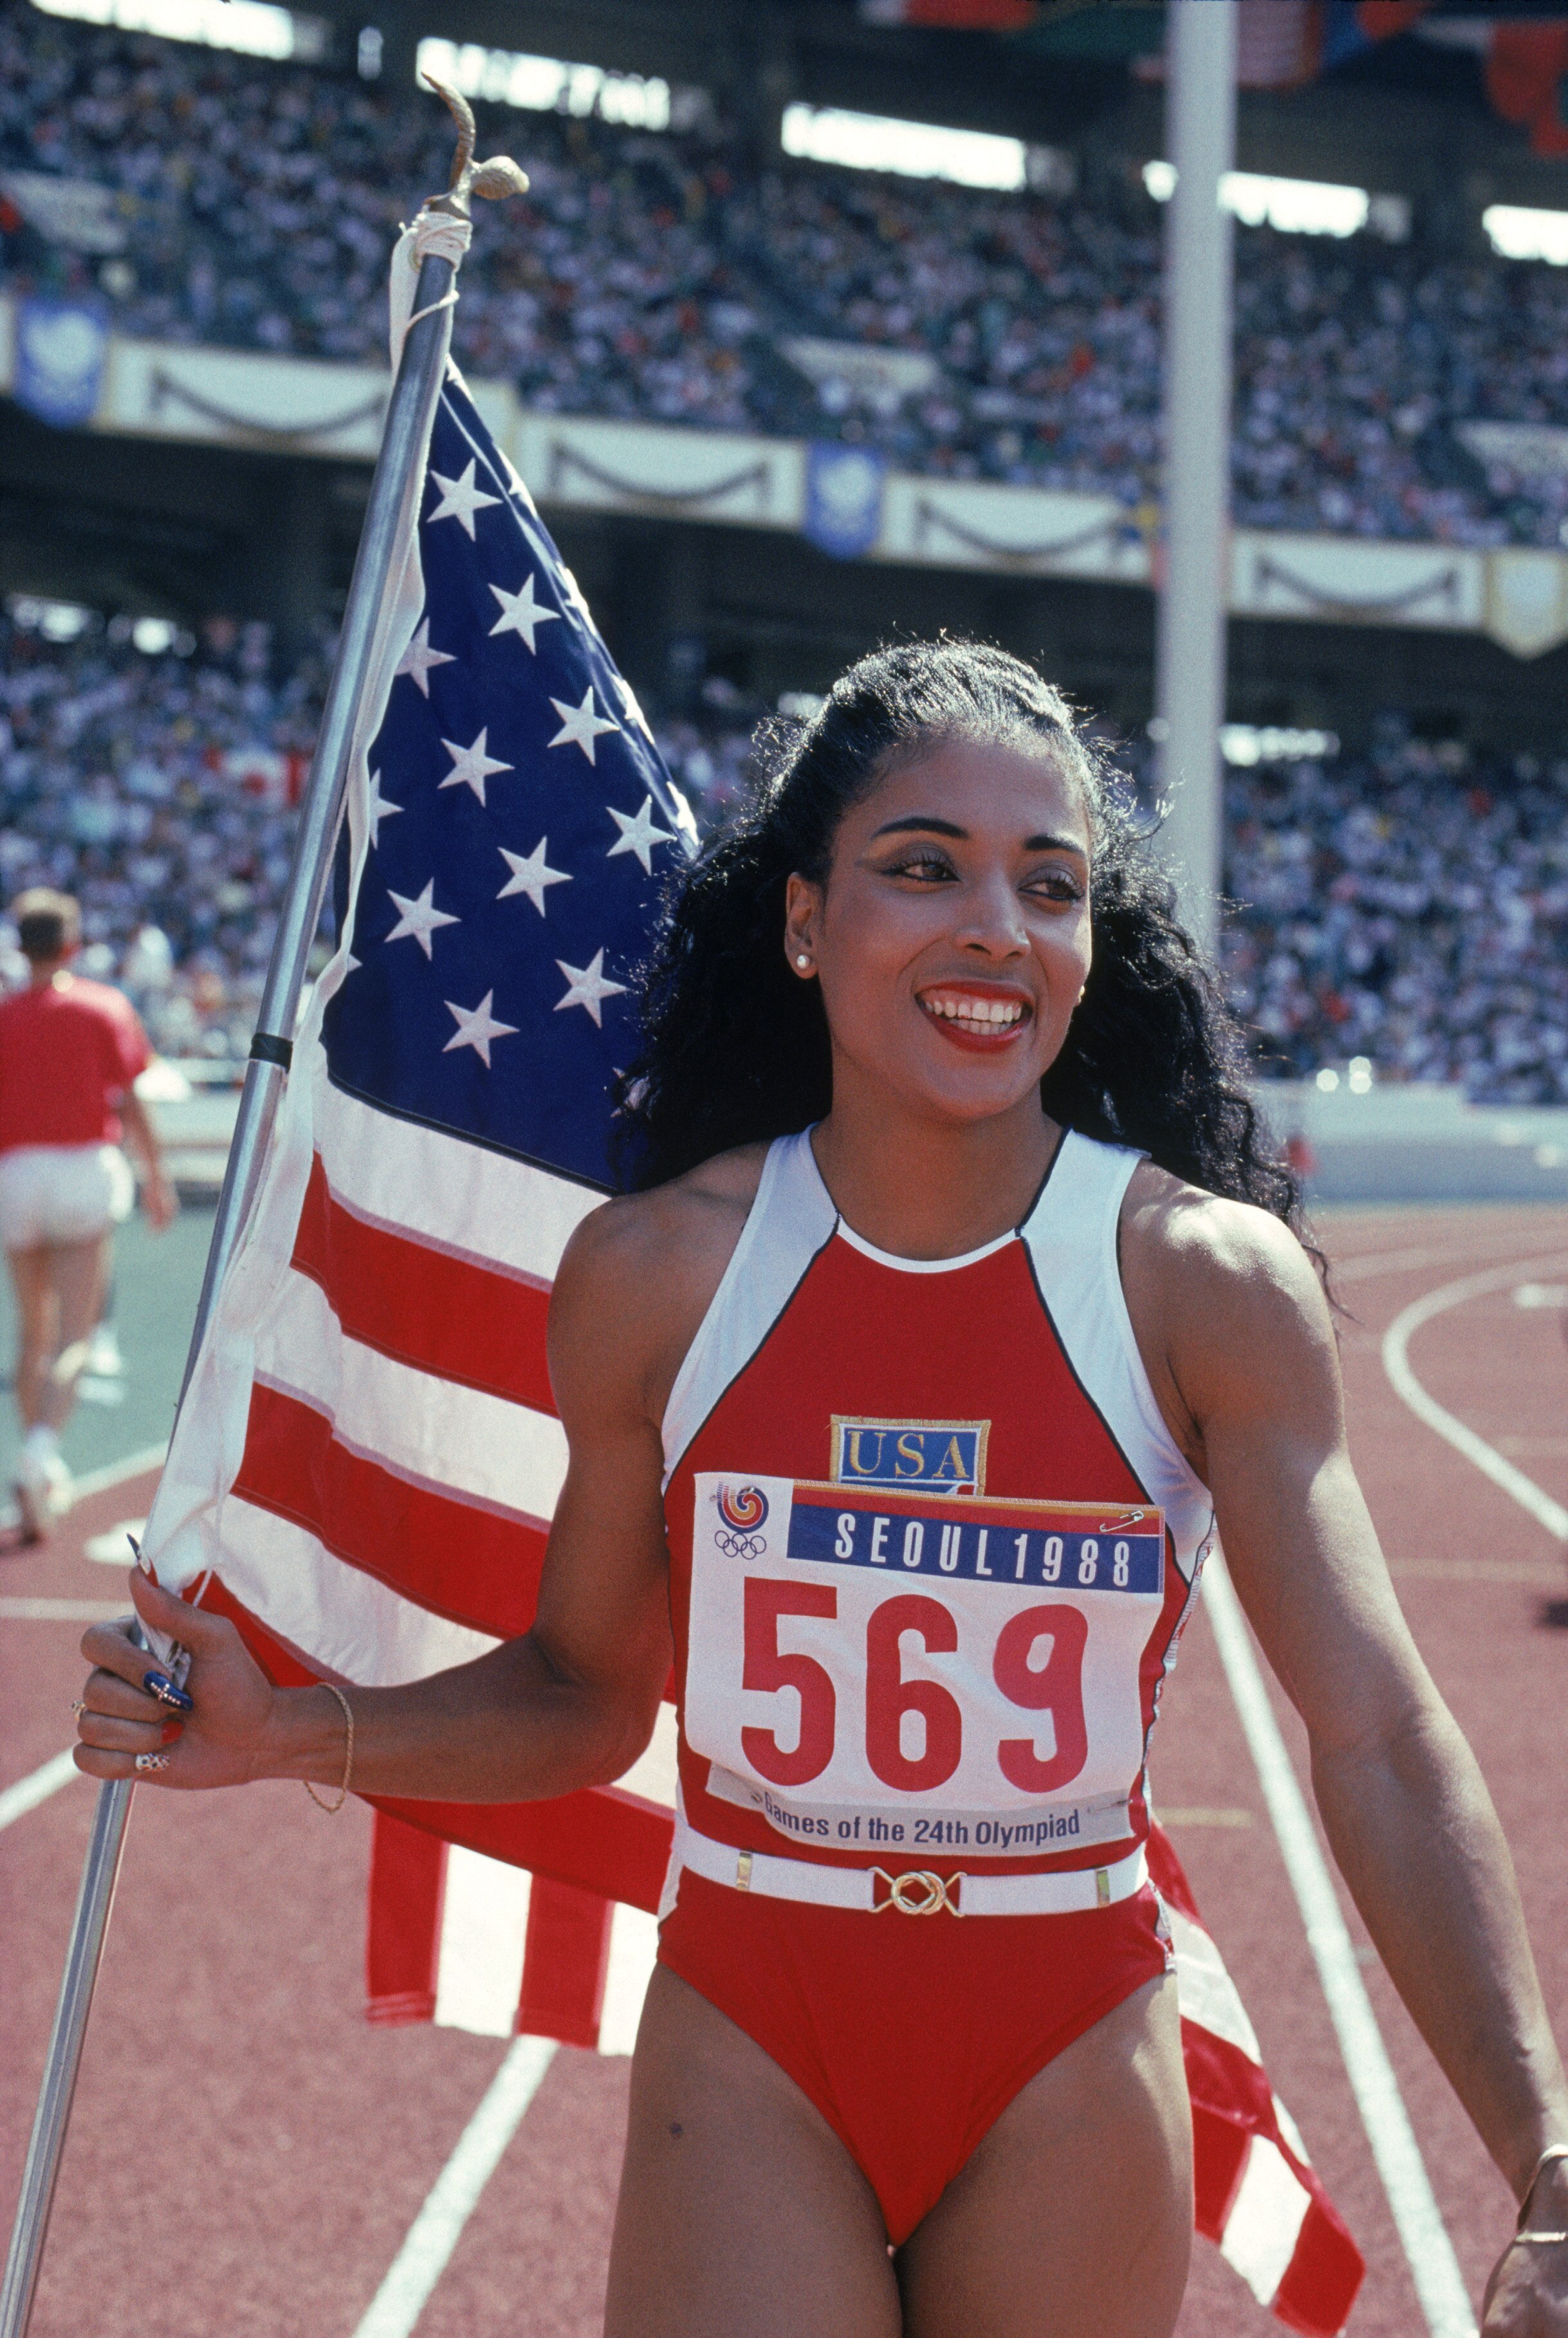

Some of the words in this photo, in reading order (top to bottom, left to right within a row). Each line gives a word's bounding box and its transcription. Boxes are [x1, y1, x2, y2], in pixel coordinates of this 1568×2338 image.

[847, 1431, 970, 1478] USA
[835, 1513, 992, 1575] SEOUL
[1015, 1534, 1130, 1587] 1988
[741, 1576, 1088, 1794] 569
[764, 1791, 829, 1835] Games
[838, 1816, 861, 1839] of
[868, 1817, 905, 1842] the
[914, 1819, 968, 1844] 24th
[975, 1808, 1080, 1849] Olympiad
